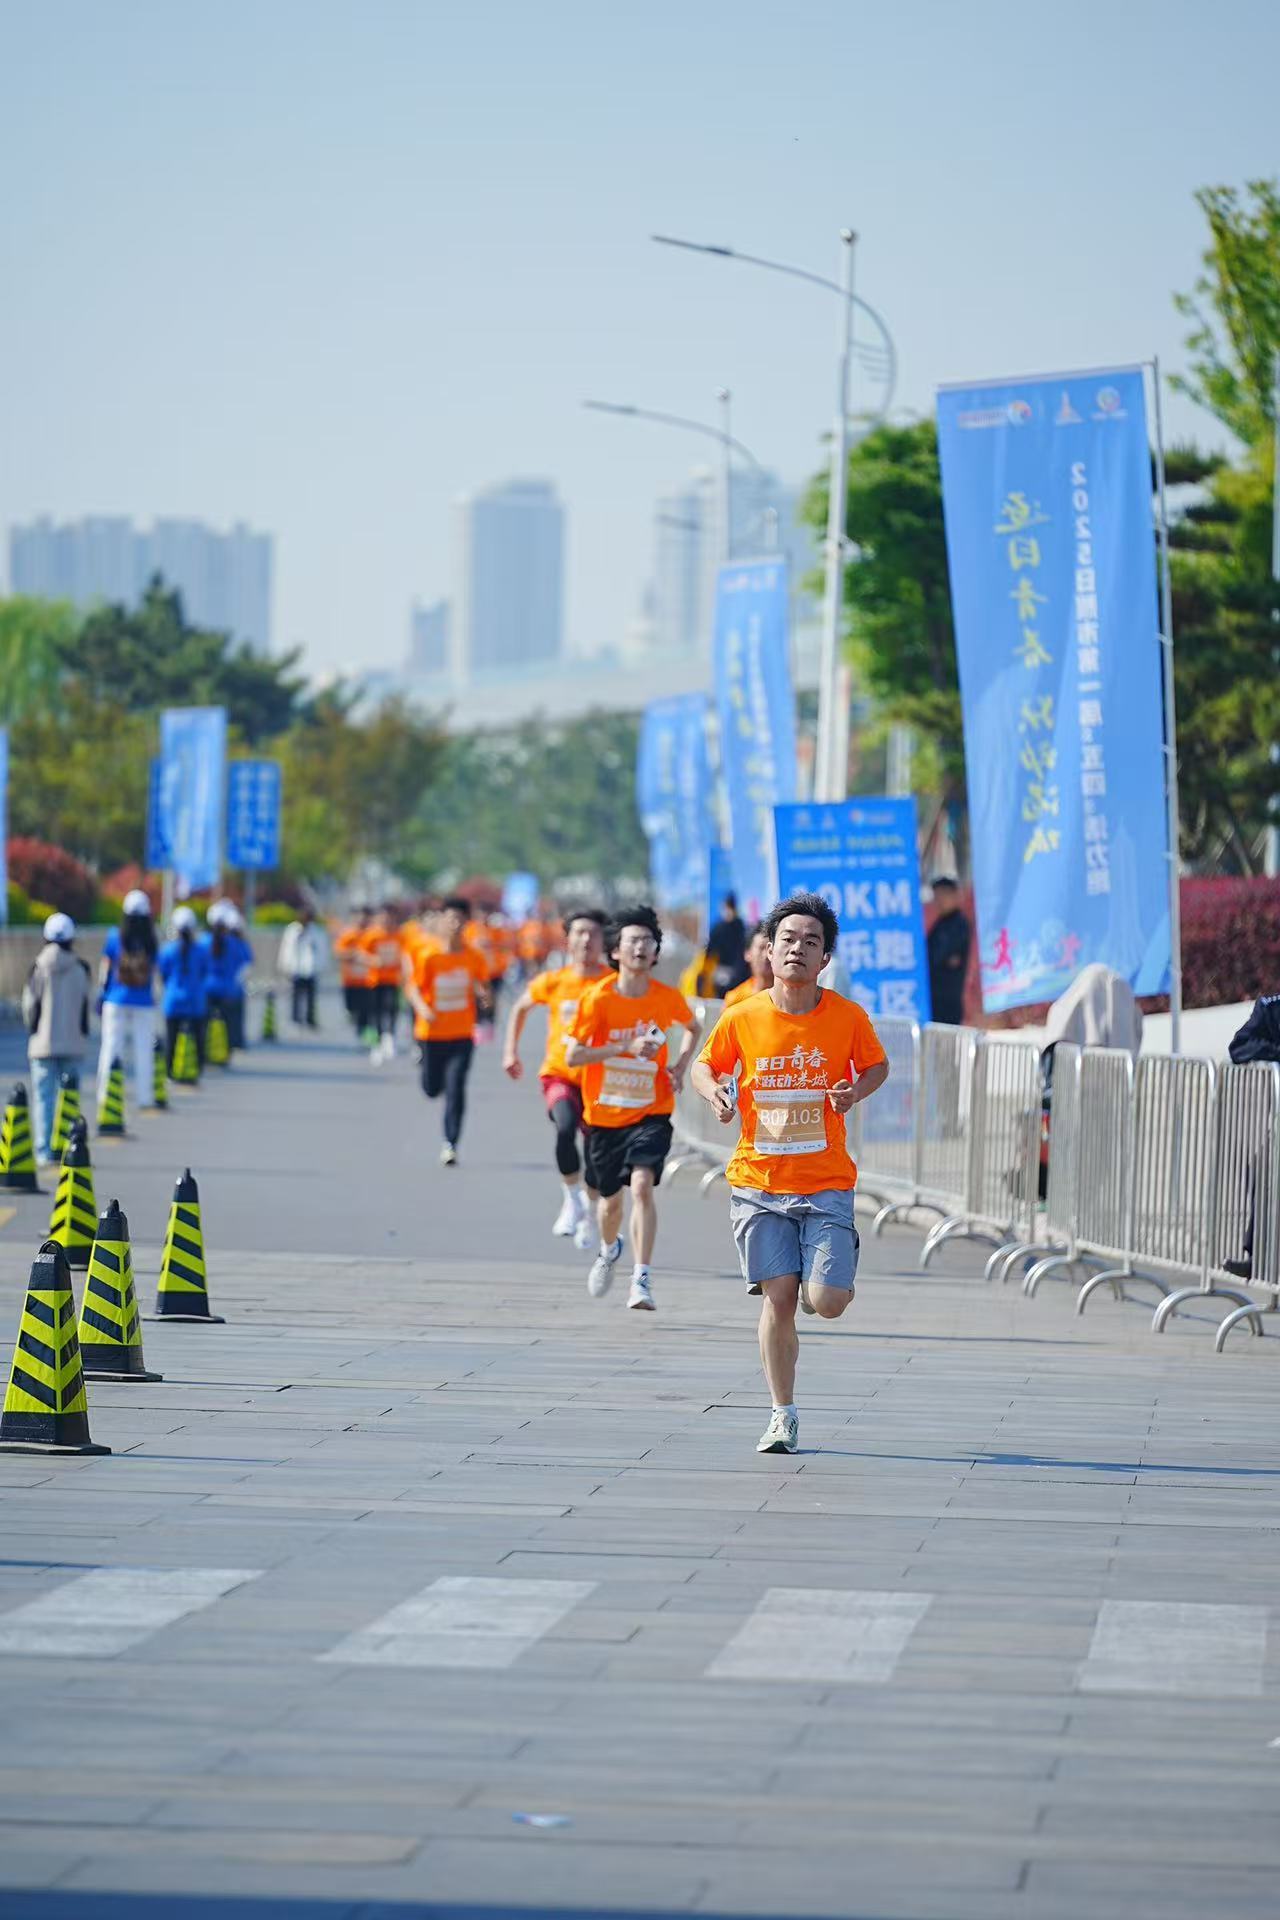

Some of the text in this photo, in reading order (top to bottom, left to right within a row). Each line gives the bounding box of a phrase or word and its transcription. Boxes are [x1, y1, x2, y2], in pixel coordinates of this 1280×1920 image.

[789, 878, 913, 919] 0KM
[755, 1044, 828, 1071] 逐日青春
[761, 1069, 829, 1090] 跃动港城
